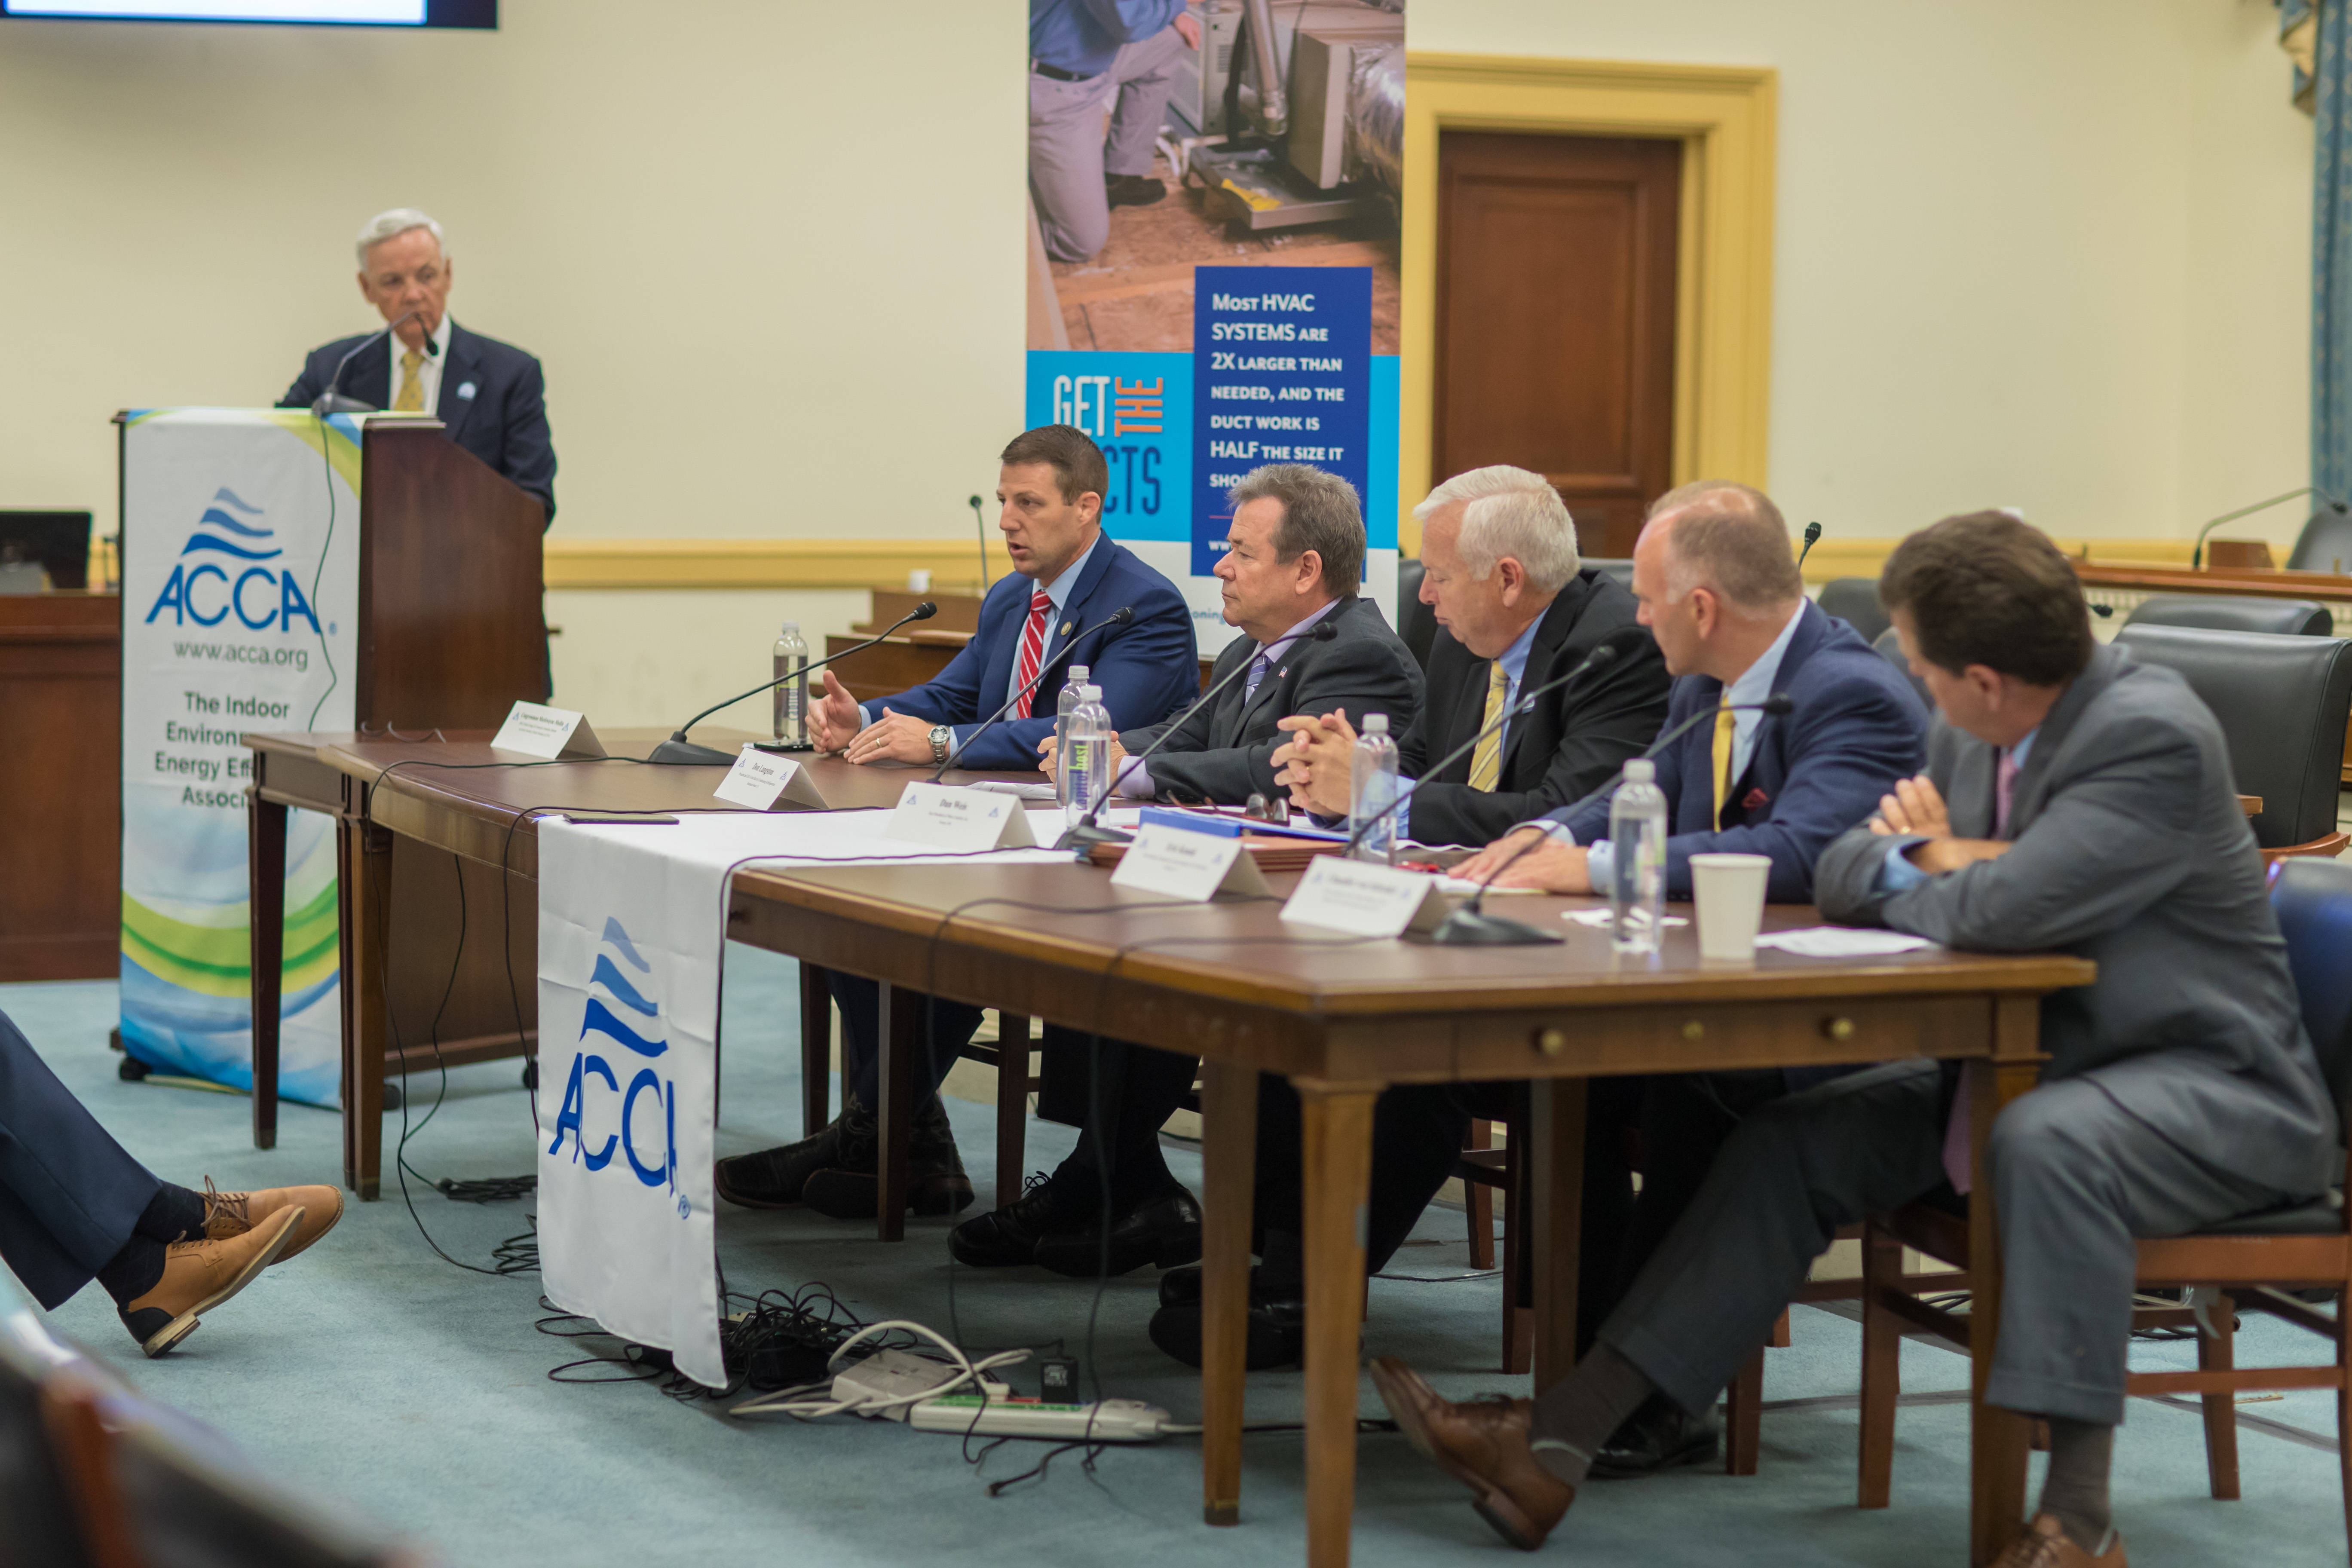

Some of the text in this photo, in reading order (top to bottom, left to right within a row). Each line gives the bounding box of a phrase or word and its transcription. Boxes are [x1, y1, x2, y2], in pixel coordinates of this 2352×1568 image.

[1262, 294, 1315, 312] HVAC
[1212, 323, 1329, 341] SYSTEMS ARE
[1211, 352, 1342, 371] 2X LARGER THAN
[1054, 375, 1163, 437] GET THE
[1211, 386, 1344, 403] NEEDED, AND THE
[1211, 415, 1320, 431] DUCT WORK IS
[1210, 441, 1344, 461] HALF THE SIZE IT
[1102, 445, 1161, 515] CTS
[1208, 540, 1231, 551] ww
[144, 563, 323, 634] ACCA
[1190, 607, 1226, 625] oning
[174, 641, 308, 672] www.acca.org
[184, 691, 290, 718] The Indoor
[166, 720, 242, 746] Environ
[155, 751, 253, 781] Energy Eff
[182, 785, 248, 808] Associ
[548, 1052, 677, 1198] ACC
